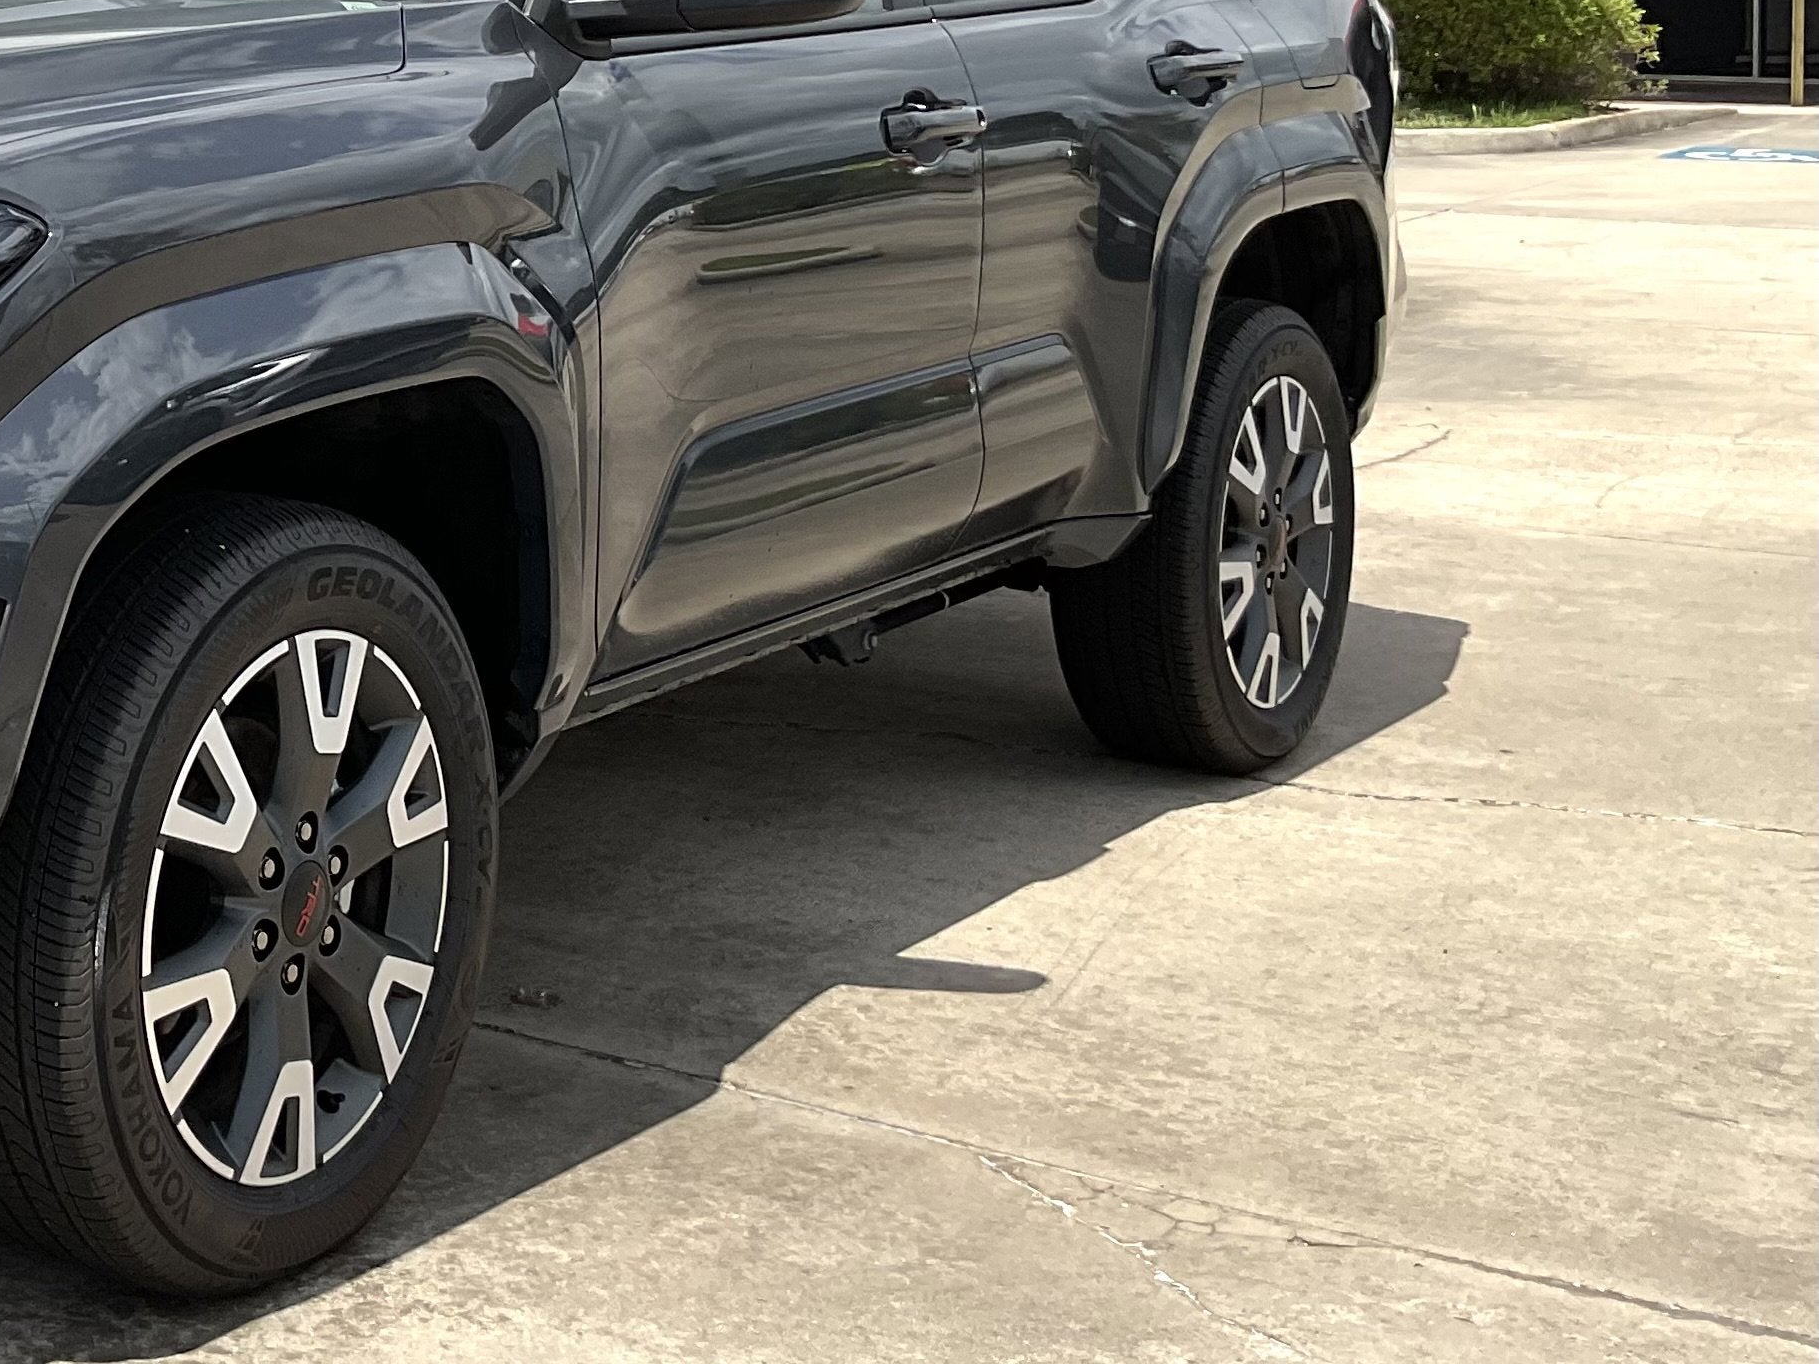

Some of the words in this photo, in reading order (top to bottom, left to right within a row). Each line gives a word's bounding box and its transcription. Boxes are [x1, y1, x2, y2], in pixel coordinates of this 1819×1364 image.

[306, 566, 486, 753] GEOLANDAR
[296, 873, 322, 937] TRD
[111, 991, 193, 1228] YOKOHAMA
